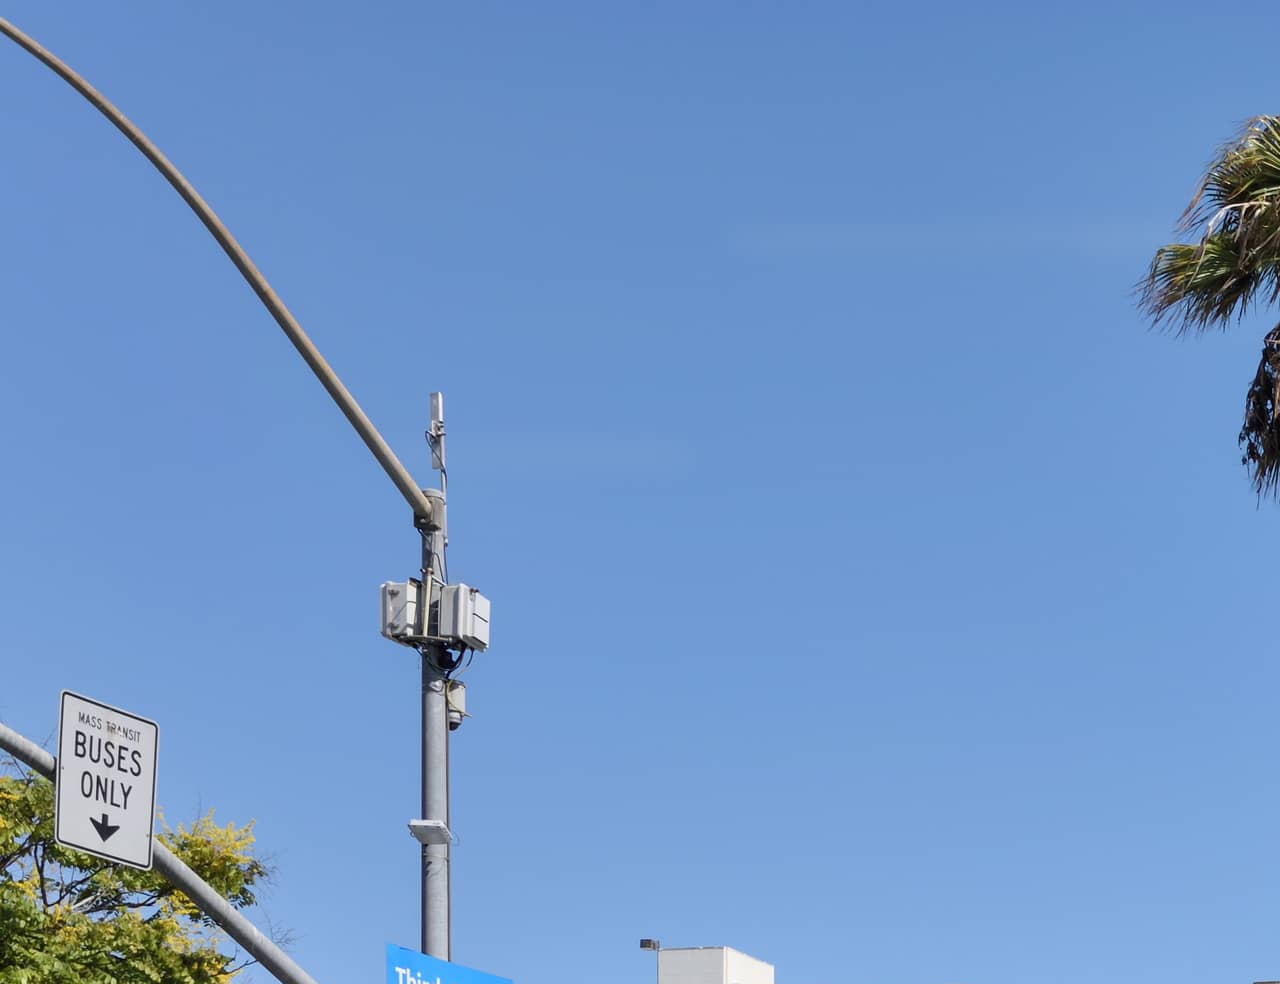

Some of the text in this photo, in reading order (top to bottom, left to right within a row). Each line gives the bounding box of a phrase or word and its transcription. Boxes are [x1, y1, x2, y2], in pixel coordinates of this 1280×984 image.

[78, 711, 141, 743] MASS TRANSIT
[74, 730, 142, 777] BUSES
[81, 770, 133, 810] ONLY
